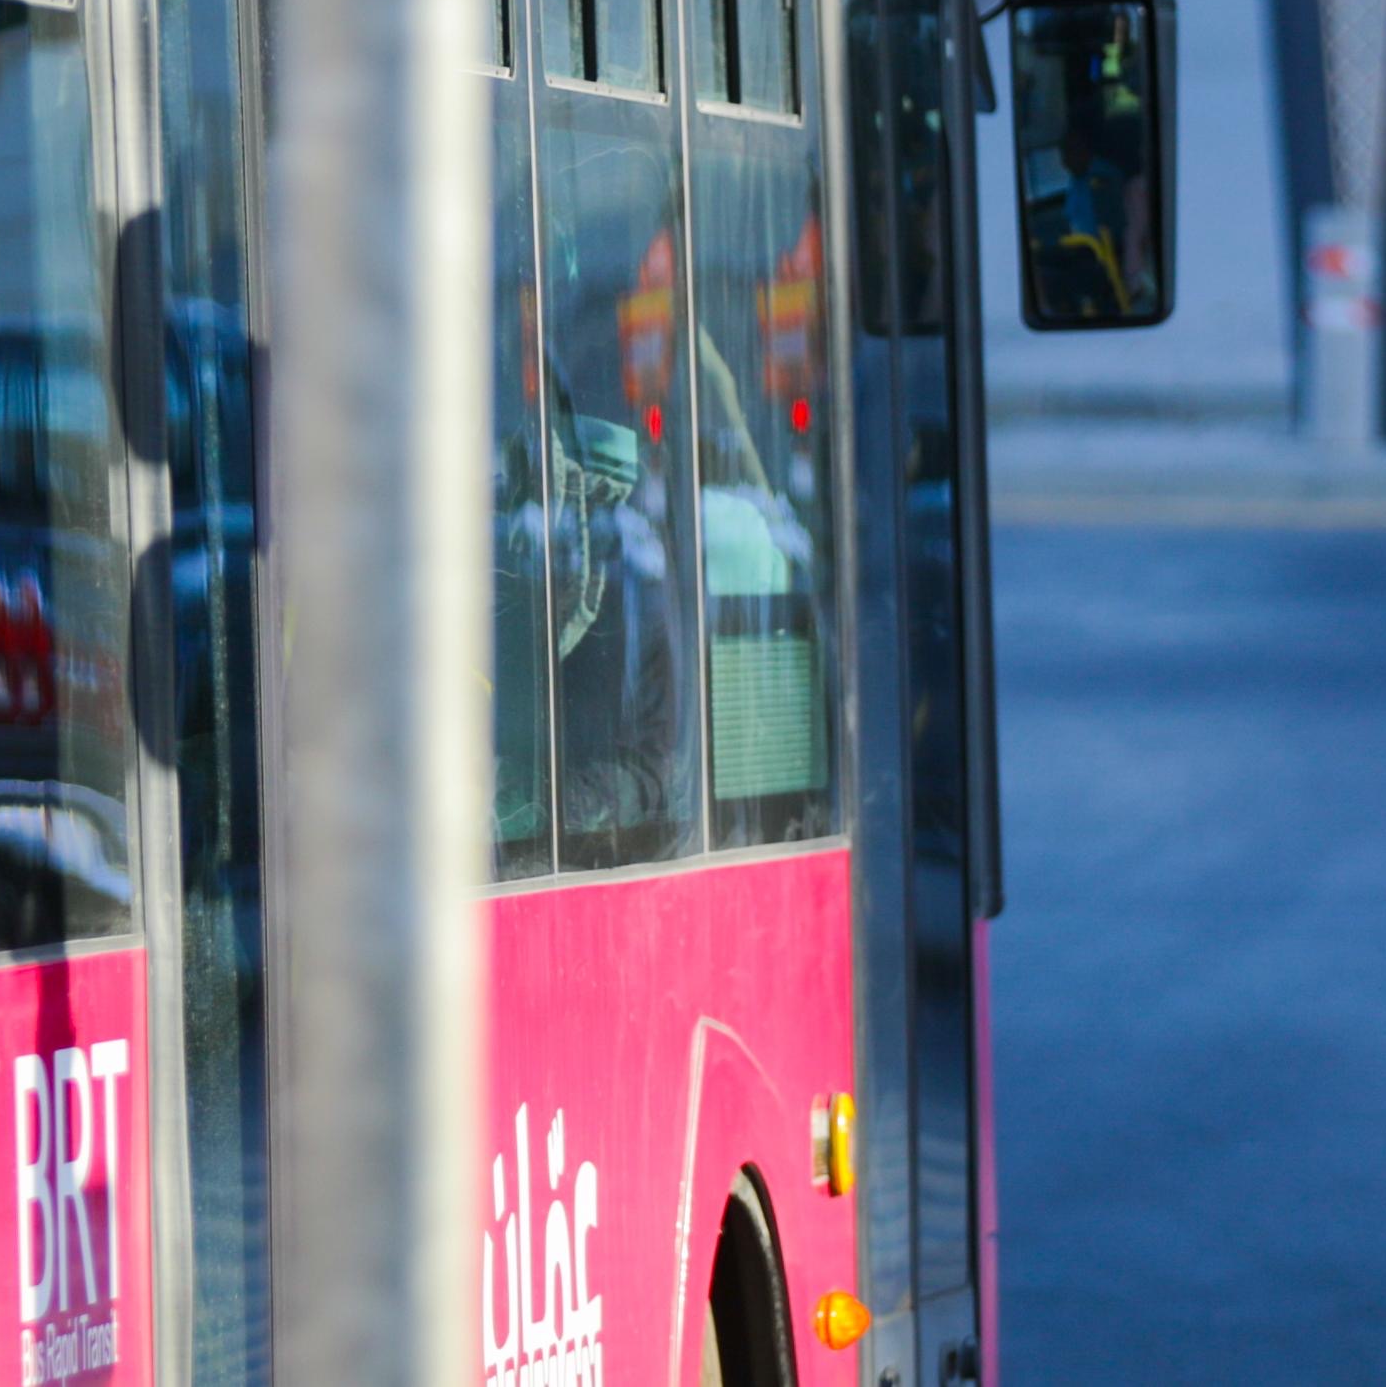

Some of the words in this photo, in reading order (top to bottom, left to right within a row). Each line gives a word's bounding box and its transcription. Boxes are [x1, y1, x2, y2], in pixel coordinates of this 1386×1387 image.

[14, 1039, 128, 1323] BRT
[21, 1329, 44, 1387] Bus
[45, 1317, 79, 1387] Rapid
[79, 1309, 119, 1371] Transit
